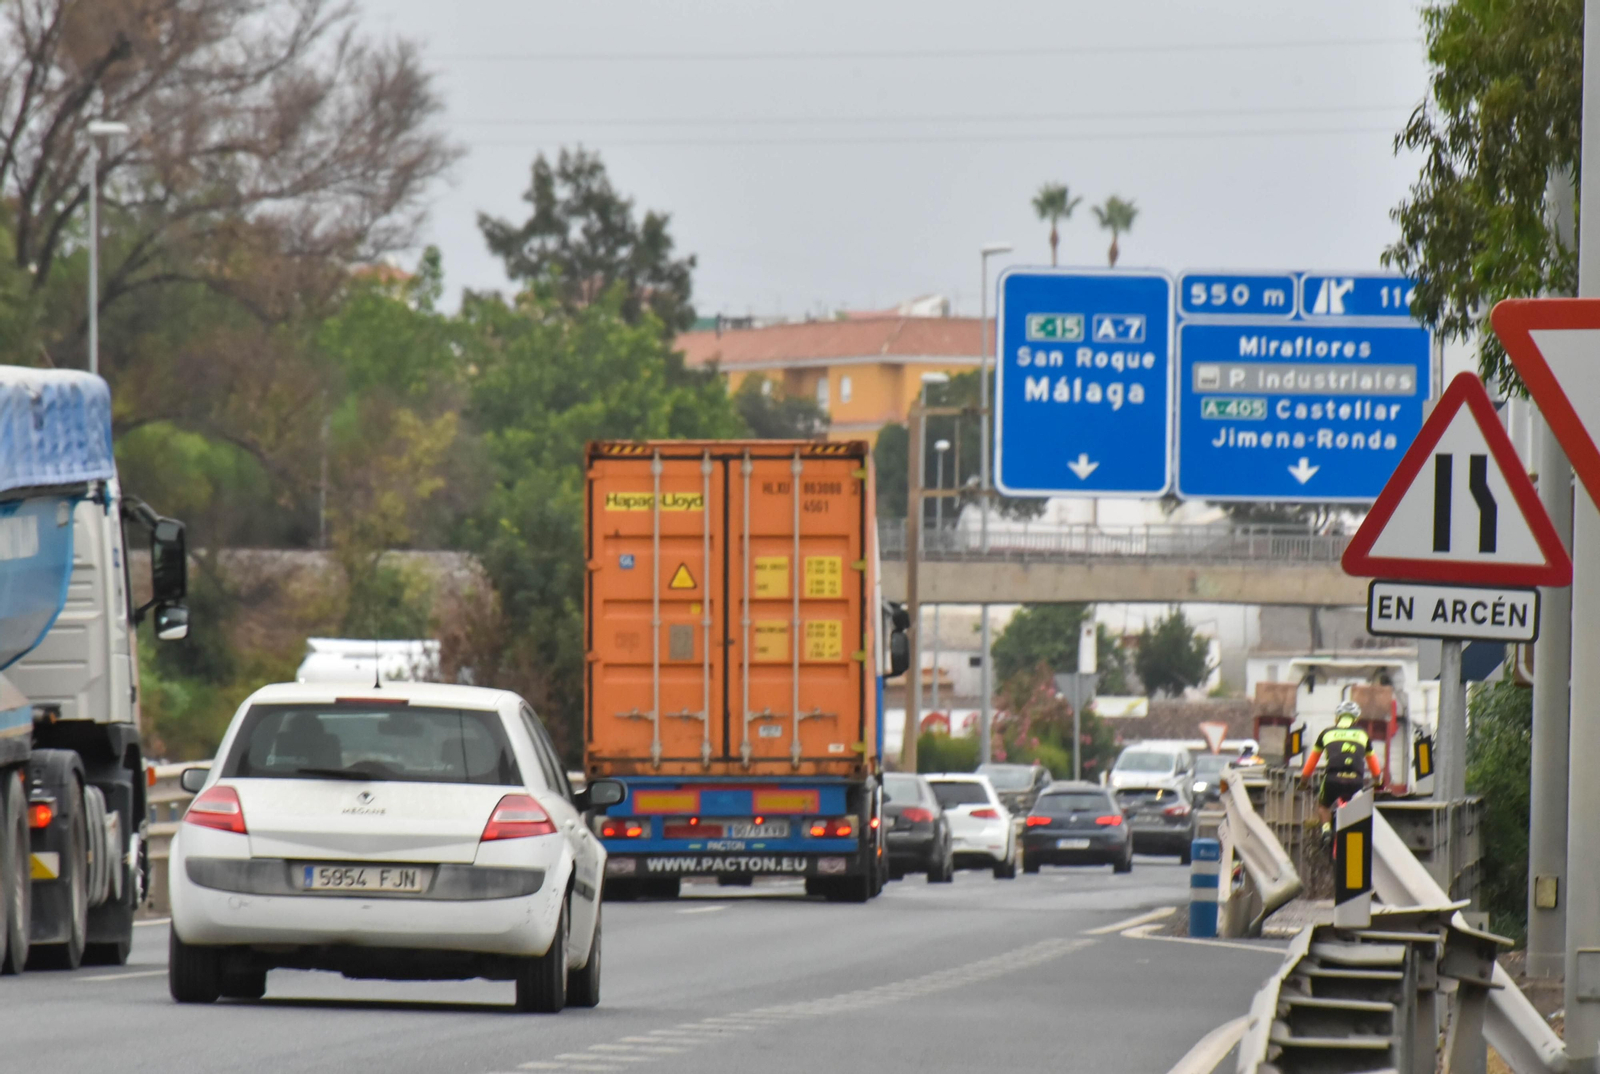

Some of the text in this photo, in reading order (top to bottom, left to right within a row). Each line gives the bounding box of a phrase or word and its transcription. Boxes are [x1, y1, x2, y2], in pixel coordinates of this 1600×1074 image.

[1190, 283, 1285, 307] 550 m
[1030, 317, 1142, 339] E-15 A-7
[1239, 336, 1372, 358] Miraflores
[1016, 345, 1156, 373] San Roque
[1258, 369, 1412, 391] Industriales
[1025, 375, 1145, 411] Málaga
[1204, 398, 1402, 421] A-405 Castellar
[1211, 427, 1398, 449] Jimena-Ronda
[1378, 595, 1528, 627] EN ARCÉN
[706, 841, 746, 851] PACTON
[646, 857, 808, 872] WWW.PACTON.EU
[380, 868, 416, 888] FJN
